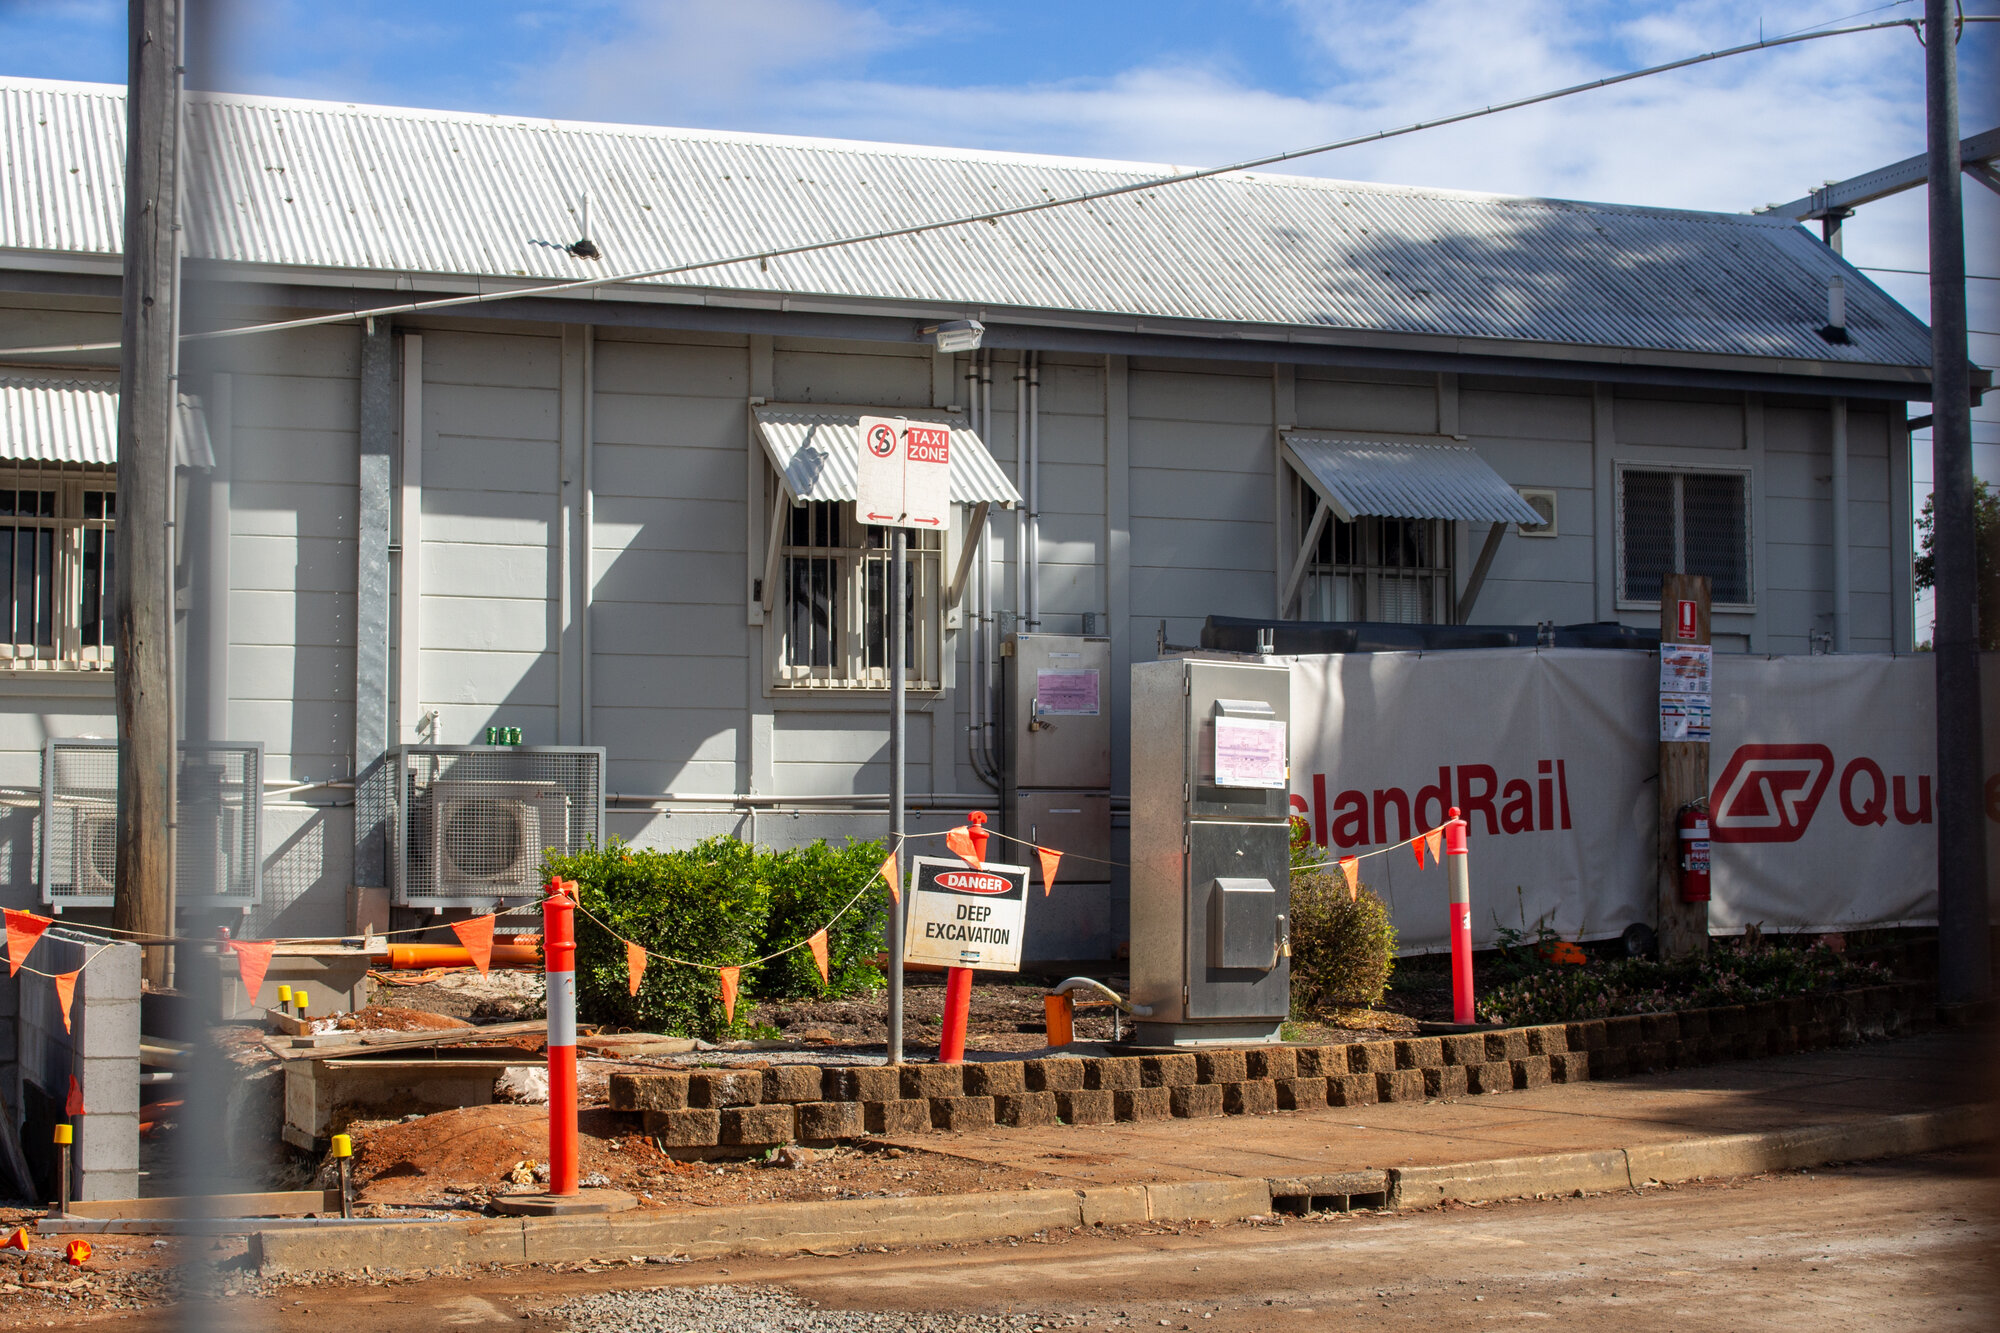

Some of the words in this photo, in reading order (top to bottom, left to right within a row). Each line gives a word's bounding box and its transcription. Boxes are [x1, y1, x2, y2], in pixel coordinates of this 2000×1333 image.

[912, 430, 945, 445] TAXI
[910, 446, 947, 461] ZONE
[948, 875, 1002, 890] DANGER
[957, 904, 991, 921] DEEP
[926, 922, 1009, 944] EXCAVATION
